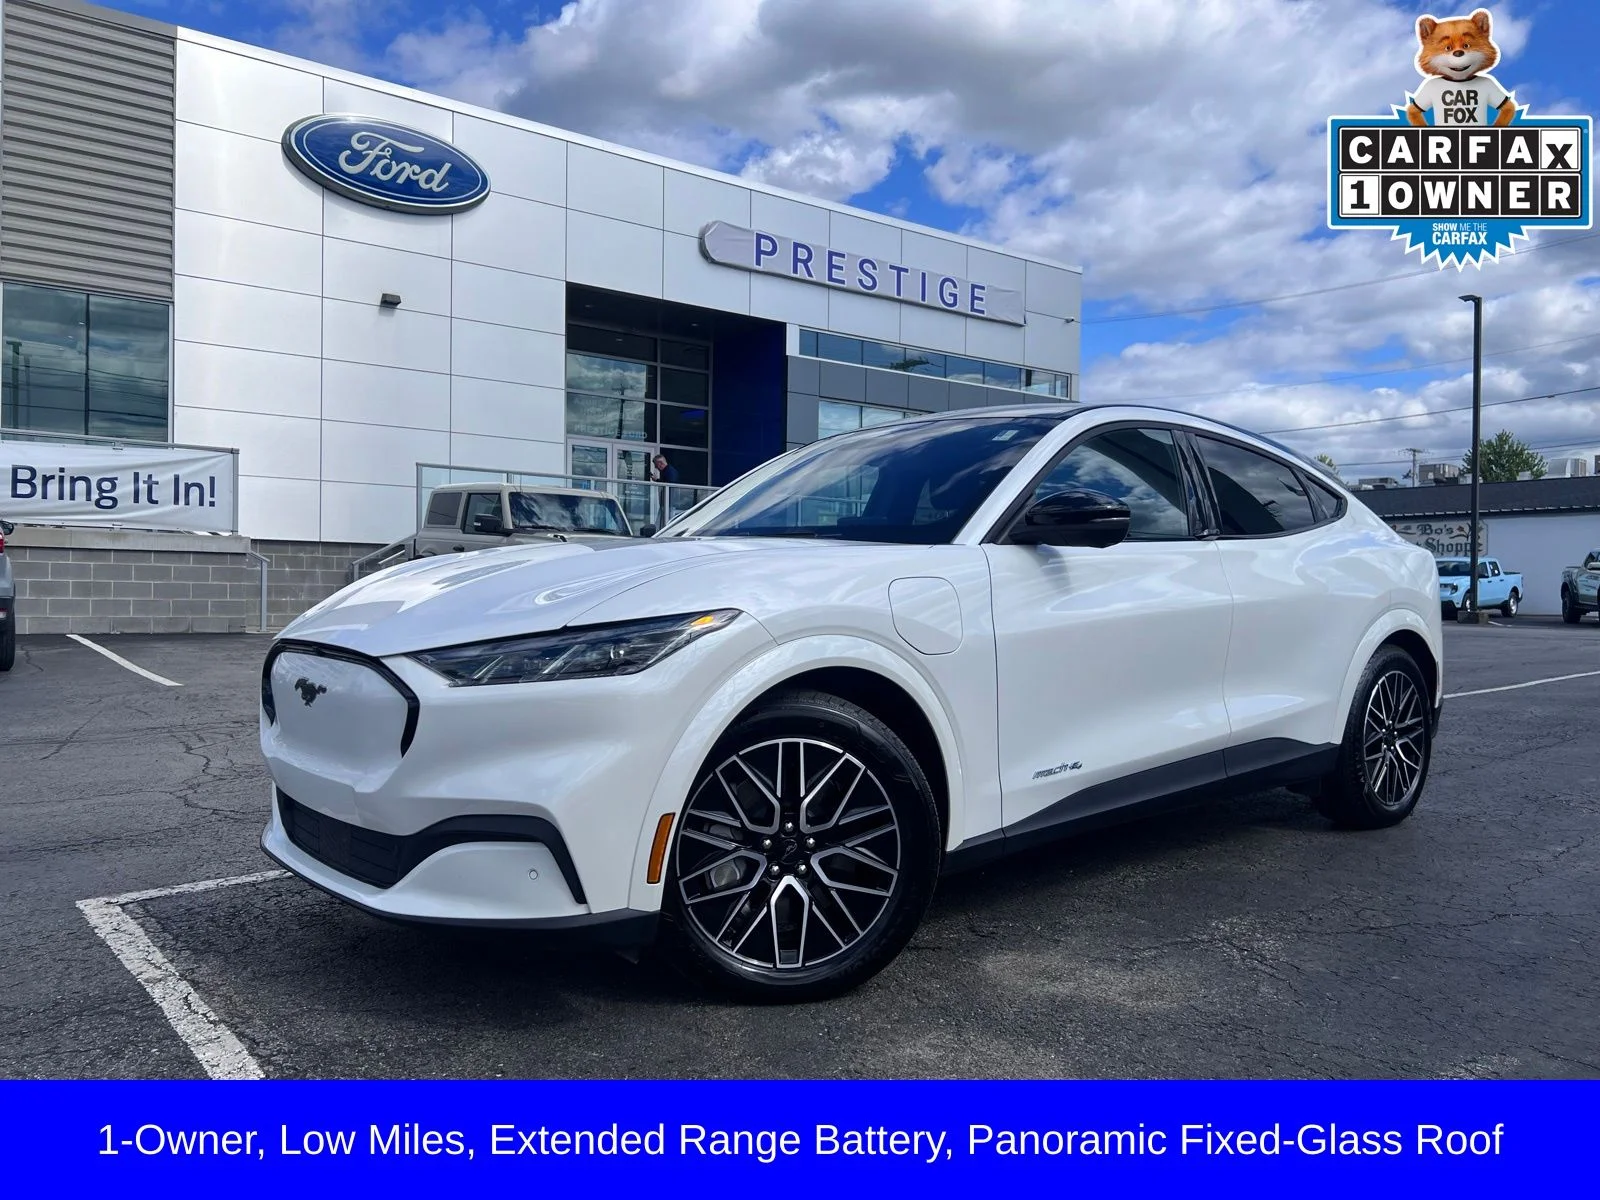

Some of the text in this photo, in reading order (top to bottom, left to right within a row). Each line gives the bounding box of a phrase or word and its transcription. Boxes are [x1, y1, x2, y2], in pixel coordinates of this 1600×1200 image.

[338, 131, 452, 193] Ford
[754, 232, 986, 315] PRESTIGE
[11, 465, 215, 509] Bring It In!
[1424, 537, 1480, 556] Shopp
